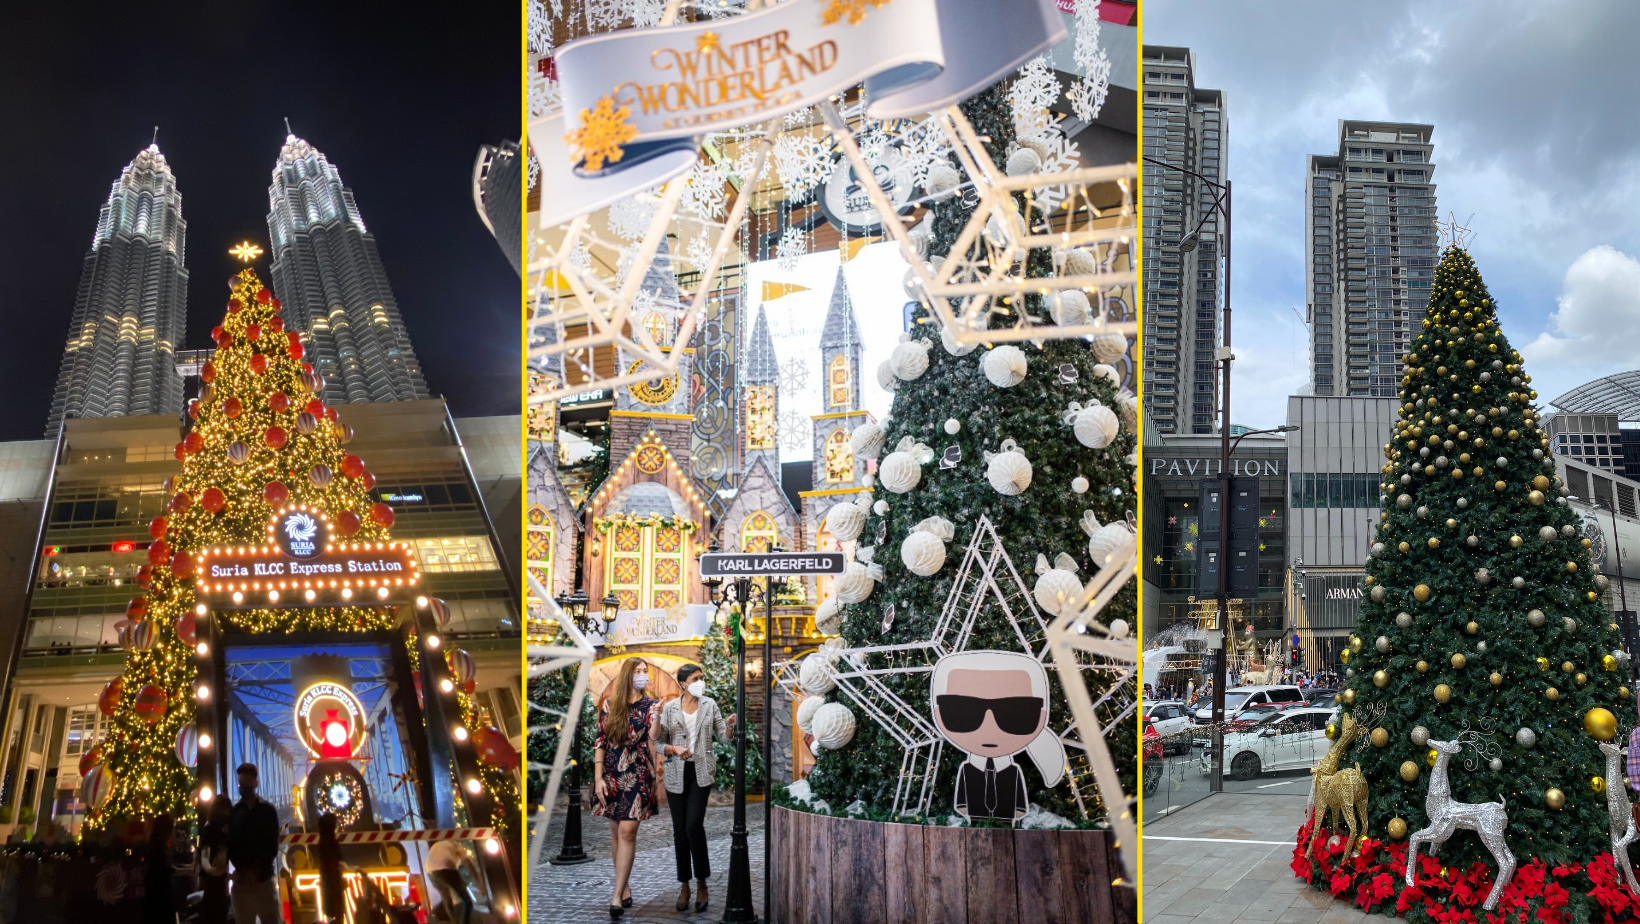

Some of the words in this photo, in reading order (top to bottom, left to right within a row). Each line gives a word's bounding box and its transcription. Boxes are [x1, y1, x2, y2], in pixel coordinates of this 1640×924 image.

[651, 29, 793, 79] WINTER
[613, 39, 838, 115] WONDERLAND
[290, 541, 315, 549] SURIA
[211, 563, 248, 577] Suria
[254, 562, 284, 575] KLCC
[290, 561, 342, 575] Express
[348, 559, 402, 573] Station
[718, 559, 753, 571] KARL
[754, 558, 833, 570] LAGERFELD
[1326, 587, 1364, 599] ARMAN
[299, 694, 313, 717] Suria
[310, 685, 333, 698] KLCC
[332, 687, 359, 716] Express
